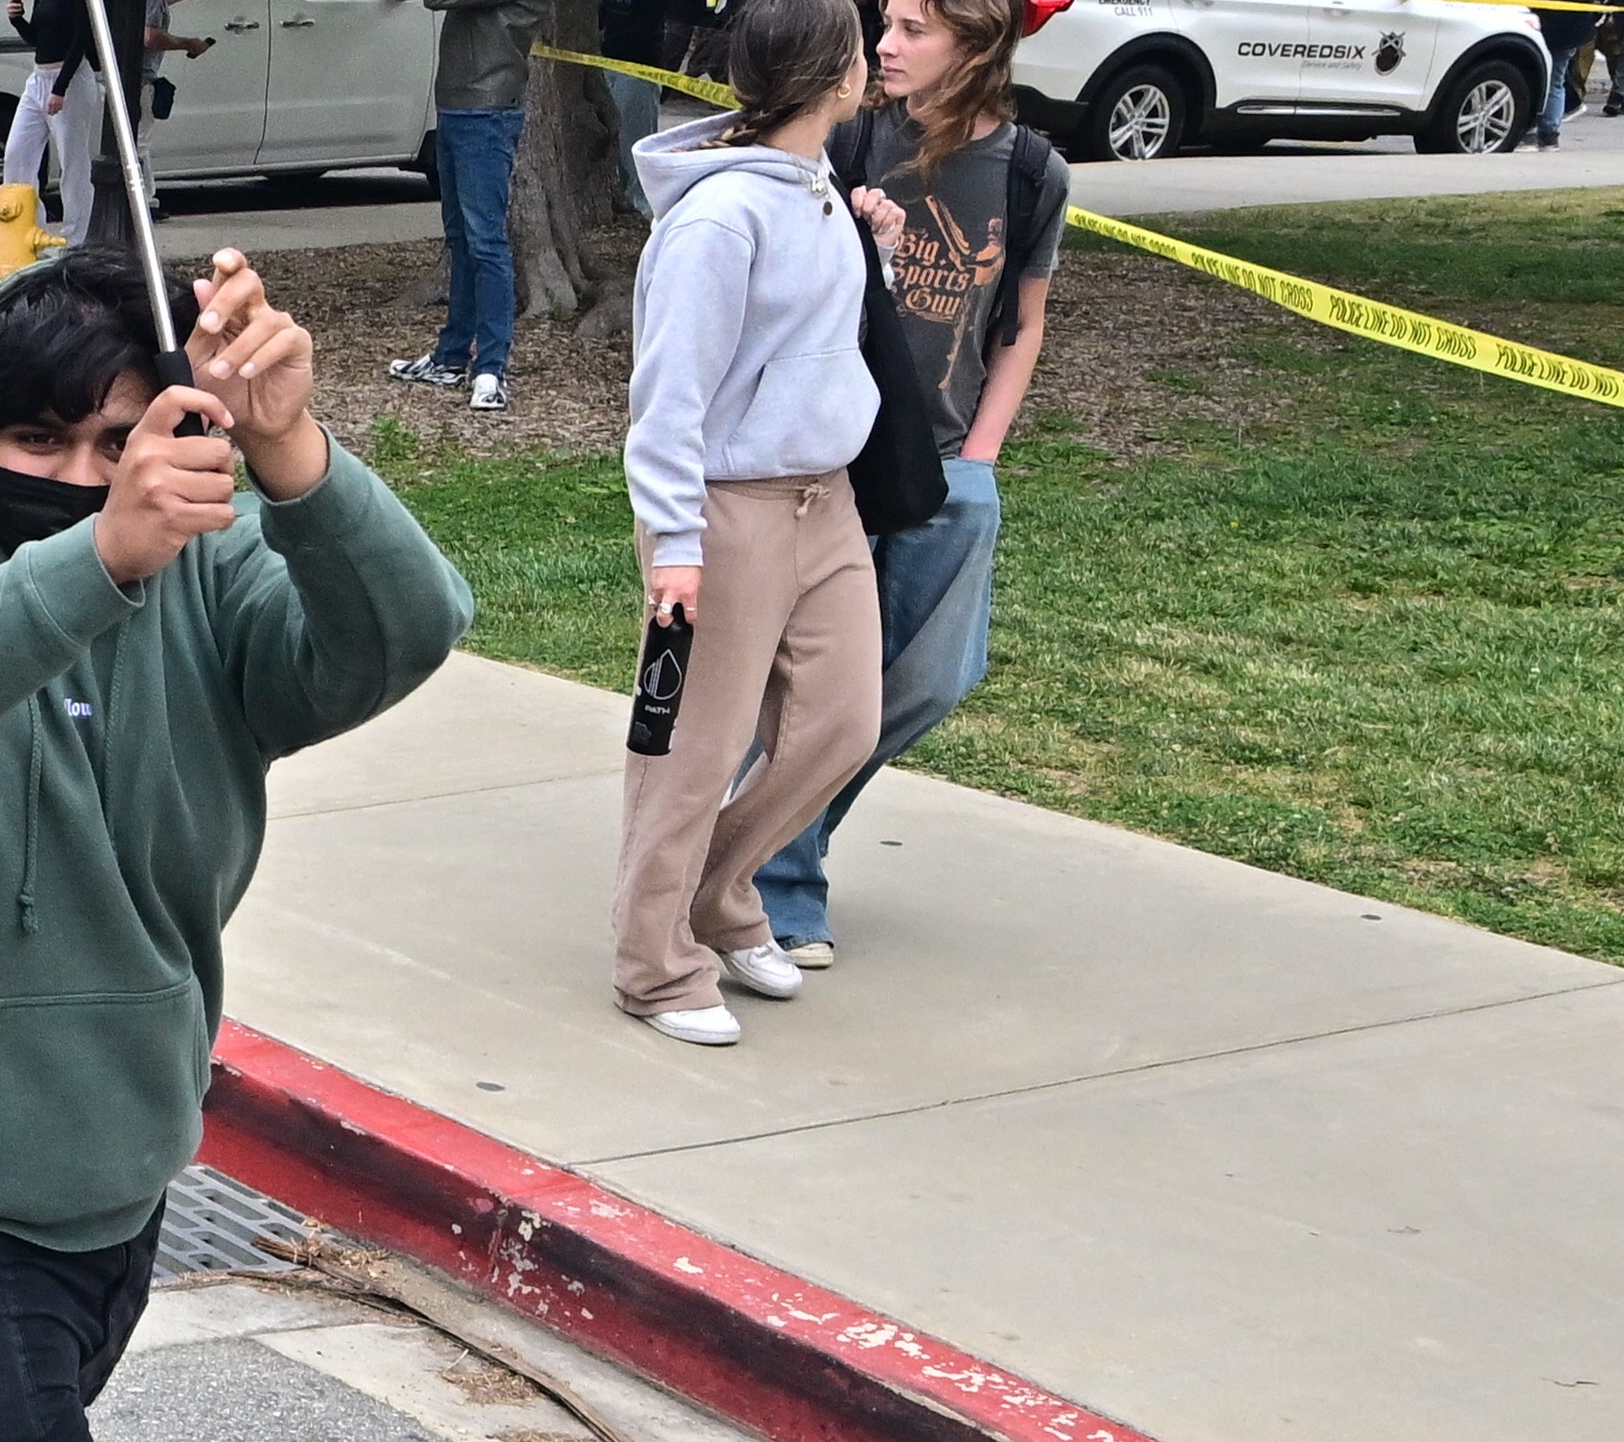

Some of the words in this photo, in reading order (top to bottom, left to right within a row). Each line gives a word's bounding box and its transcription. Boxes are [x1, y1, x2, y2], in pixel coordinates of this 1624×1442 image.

[1114, 6, 1136, 16] CALL
[1138, 7, 1153, 16] 911
[1238, 42, 1366, 59] COVEREDSIX
[892, 258, 970, 292] Sports
[1279, 280, 1314, 313] CROSS
[1329, 294, 1362, 328] POLICE
[1363, 304, 1390, 336] LINE
[1389, 313, 1408, 339] DO
[1408, 318, 1432, 348] NOT
[1435, 326, 1477, 360] CROSS
[1495, 343, 1536, 378] POLICE
[1537, 353, 1568, 385] LINE
[1569, 363, 1590, 391] DO
[1593, 370, 1620, 399] NOT
[645, 704, 670, 715] PATH
